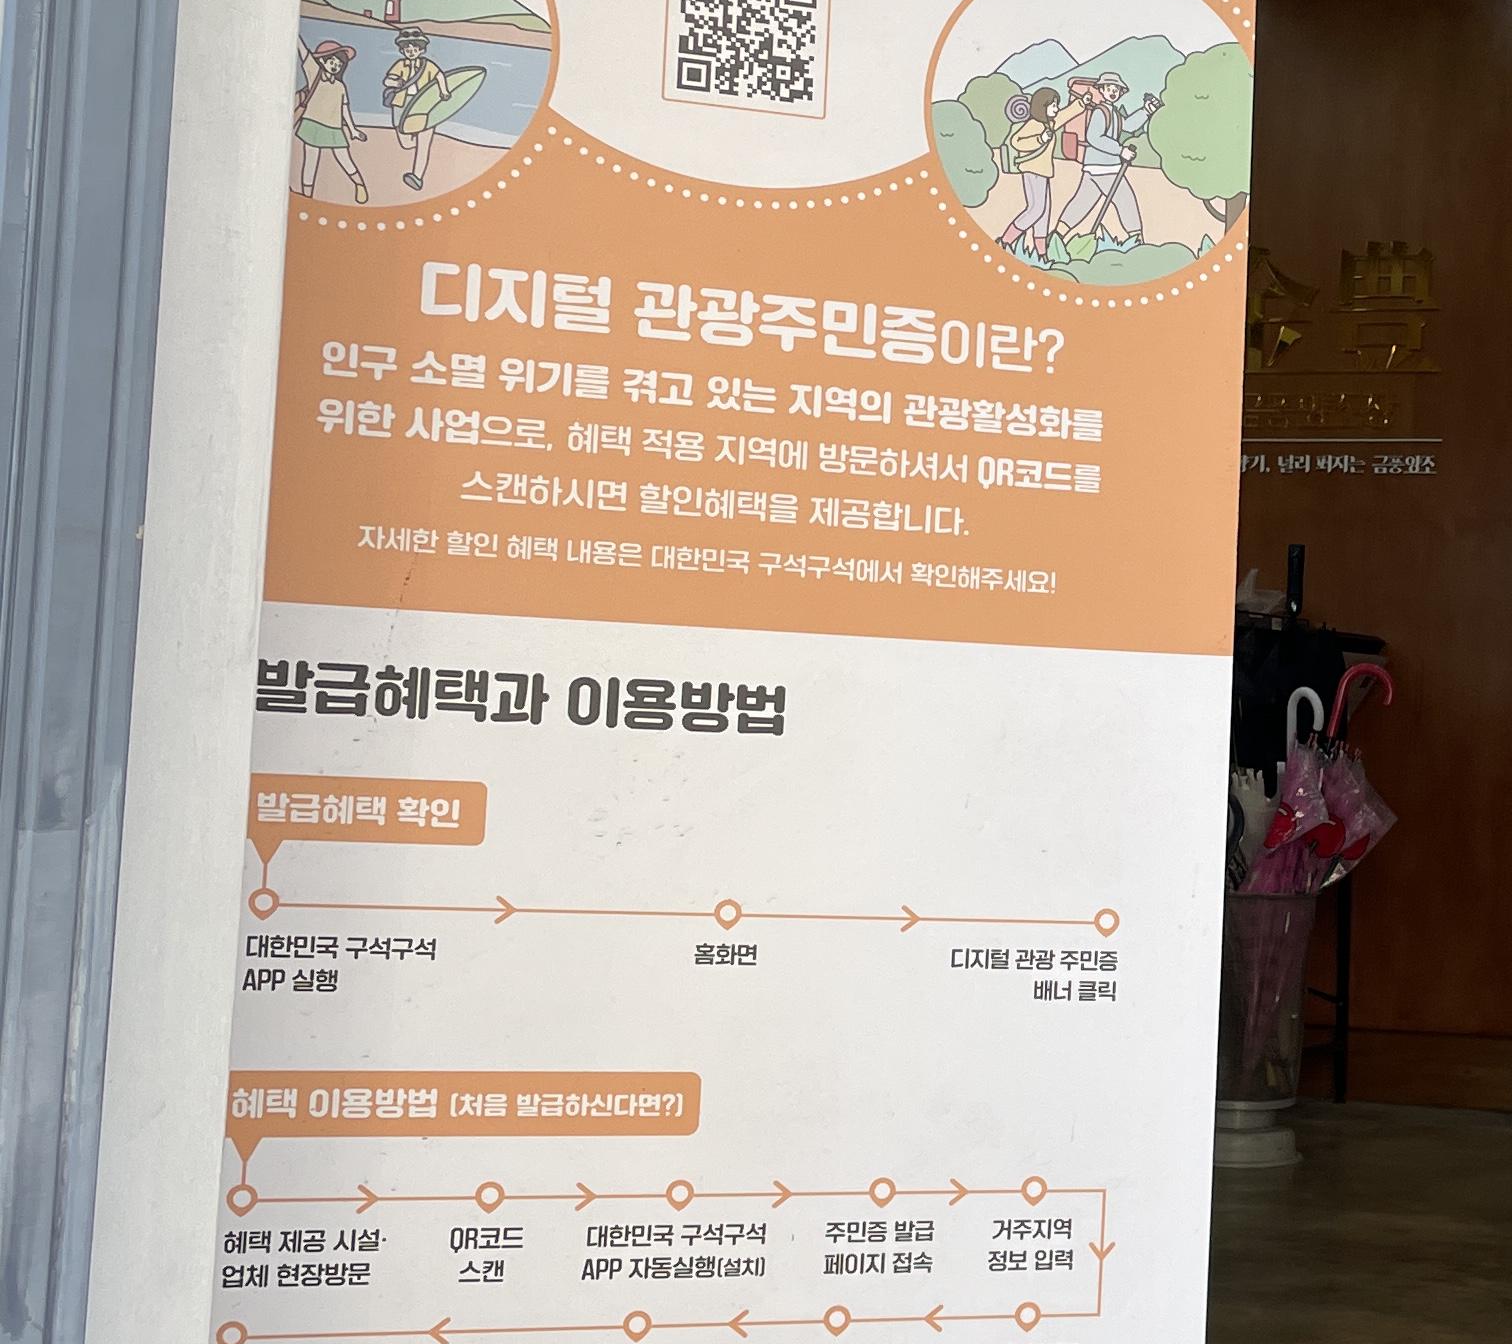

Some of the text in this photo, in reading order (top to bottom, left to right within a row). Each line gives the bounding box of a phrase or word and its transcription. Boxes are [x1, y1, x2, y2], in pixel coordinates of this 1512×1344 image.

[421, 261, 1065, 373] 디지털 관광주민증이란?
[322, 341, 1104, 442] 인구 소멸 위기를 겪고 있는 지역의 관광활성화를
[316, 399, 1102, 494] 위한 사업으로, 혜택 적용 지역에 방문하셔서 QR코드를
[461, 470, 969, 536] 스캔하시면 할인혜택을 제공합니다.
[358, 525, 1056, 594] 자세한 할인 혜택 내용은 대한민국 구석구석에서 확인해주세요!
[256, 659, 786, 736] 발급혜택과 이용방법
[257, 792, 460, 828] 발급혜택 확인
[246, 936, 437, 962] 대한민국 구석구석
[695, 943, 758, 967] 홈화면
[951, 948, 1118, 972] 디지털 관광 주민증
[242, 969, 338, 993] APP 실행
[1033, 981, 1117, 1003] 배너 클릭
[231, 1088, 298, 1120] 혜택
[308, 1088, 438, 1120] 이용방법
[223, 1230, 272, 1254] 혜택
[278, 1229, 326, 1253] 제공
[449, 1226, 524, 1254] QR코드
[586, 1222, 767, 1248] 대한민국 구석구석
[824, 1219, 935, 1243] 주민증 발급
[992, 1218, 1073, 1240] 거주지역
[458, 1260, 505, 1284] 스캔
[581, 1258, 623, 1281] APP
[823, 1252, 933, 1276] 페이지 접속
[987, 1248, 1074, 1272] 정보 입력
[222, 1262, 371, 1289] 업체 현장방문
